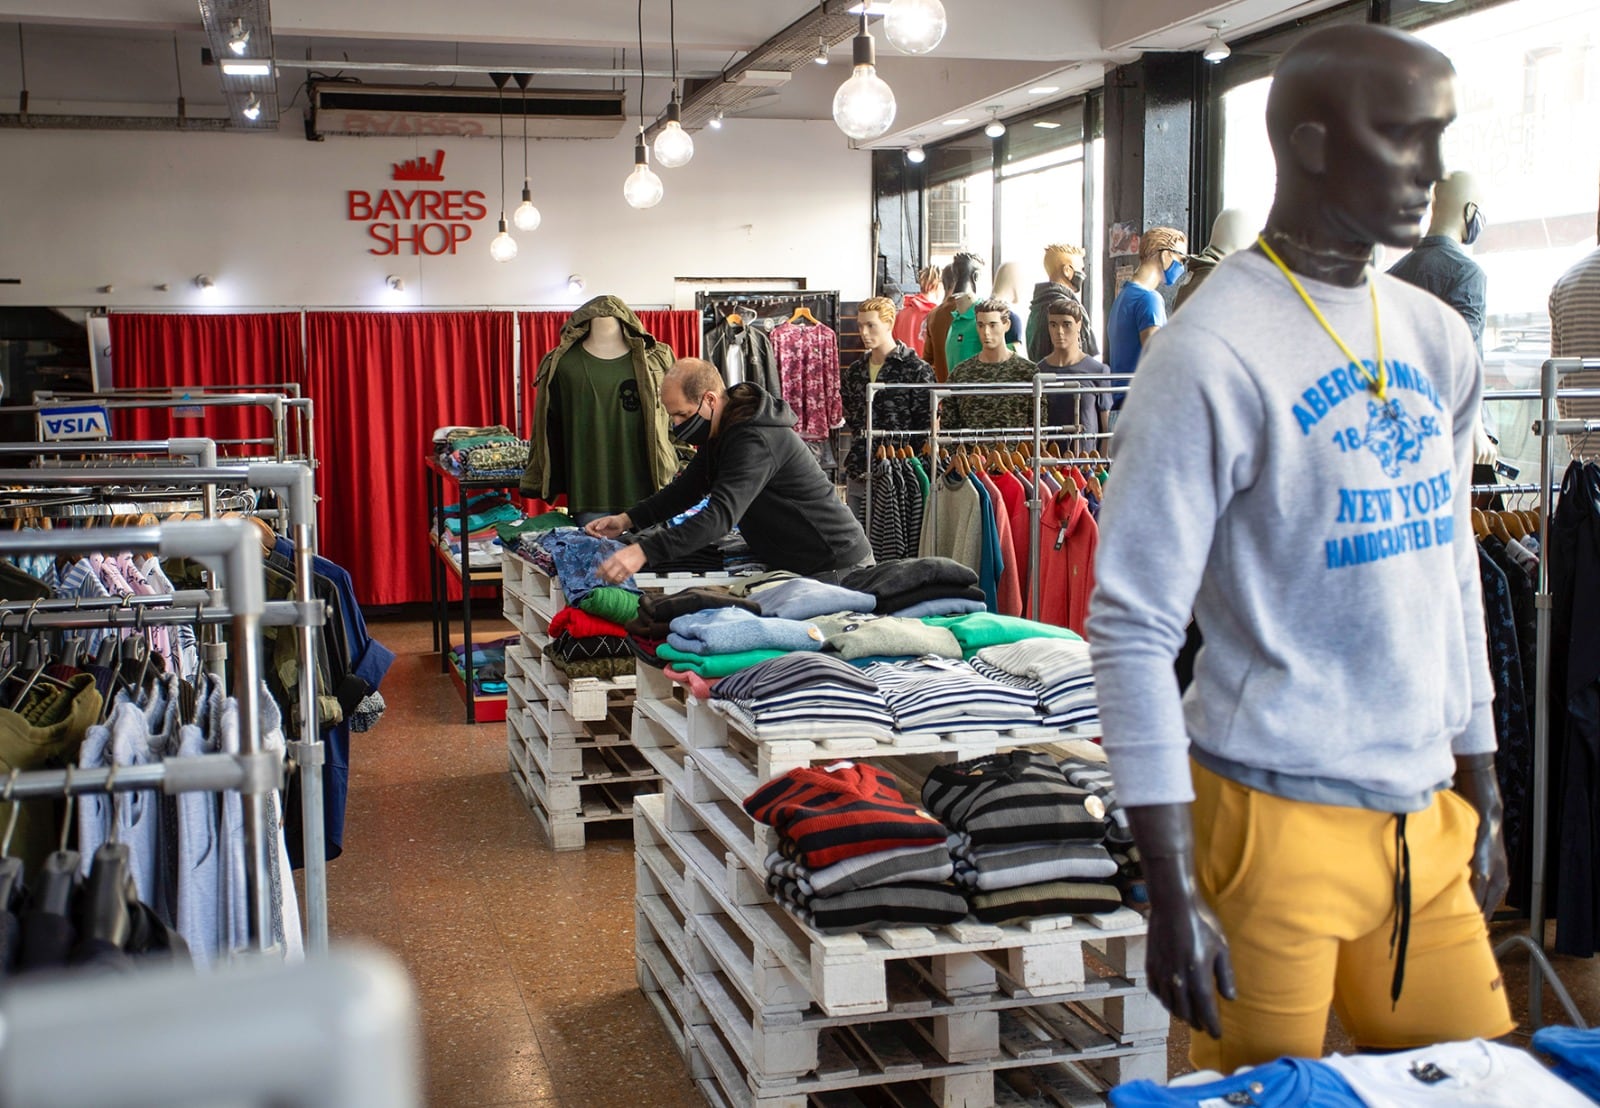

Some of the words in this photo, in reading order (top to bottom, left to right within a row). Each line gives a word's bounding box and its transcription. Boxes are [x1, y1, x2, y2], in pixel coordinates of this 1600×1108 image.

[348, 189, 487, 221] BAYRES
[368, 222, 472, 256] SHOP
[46, 417, 103, 434] VISA
[1332, 426, 1362, 453] 18
[1335, 488, 1393, 524] NEW
